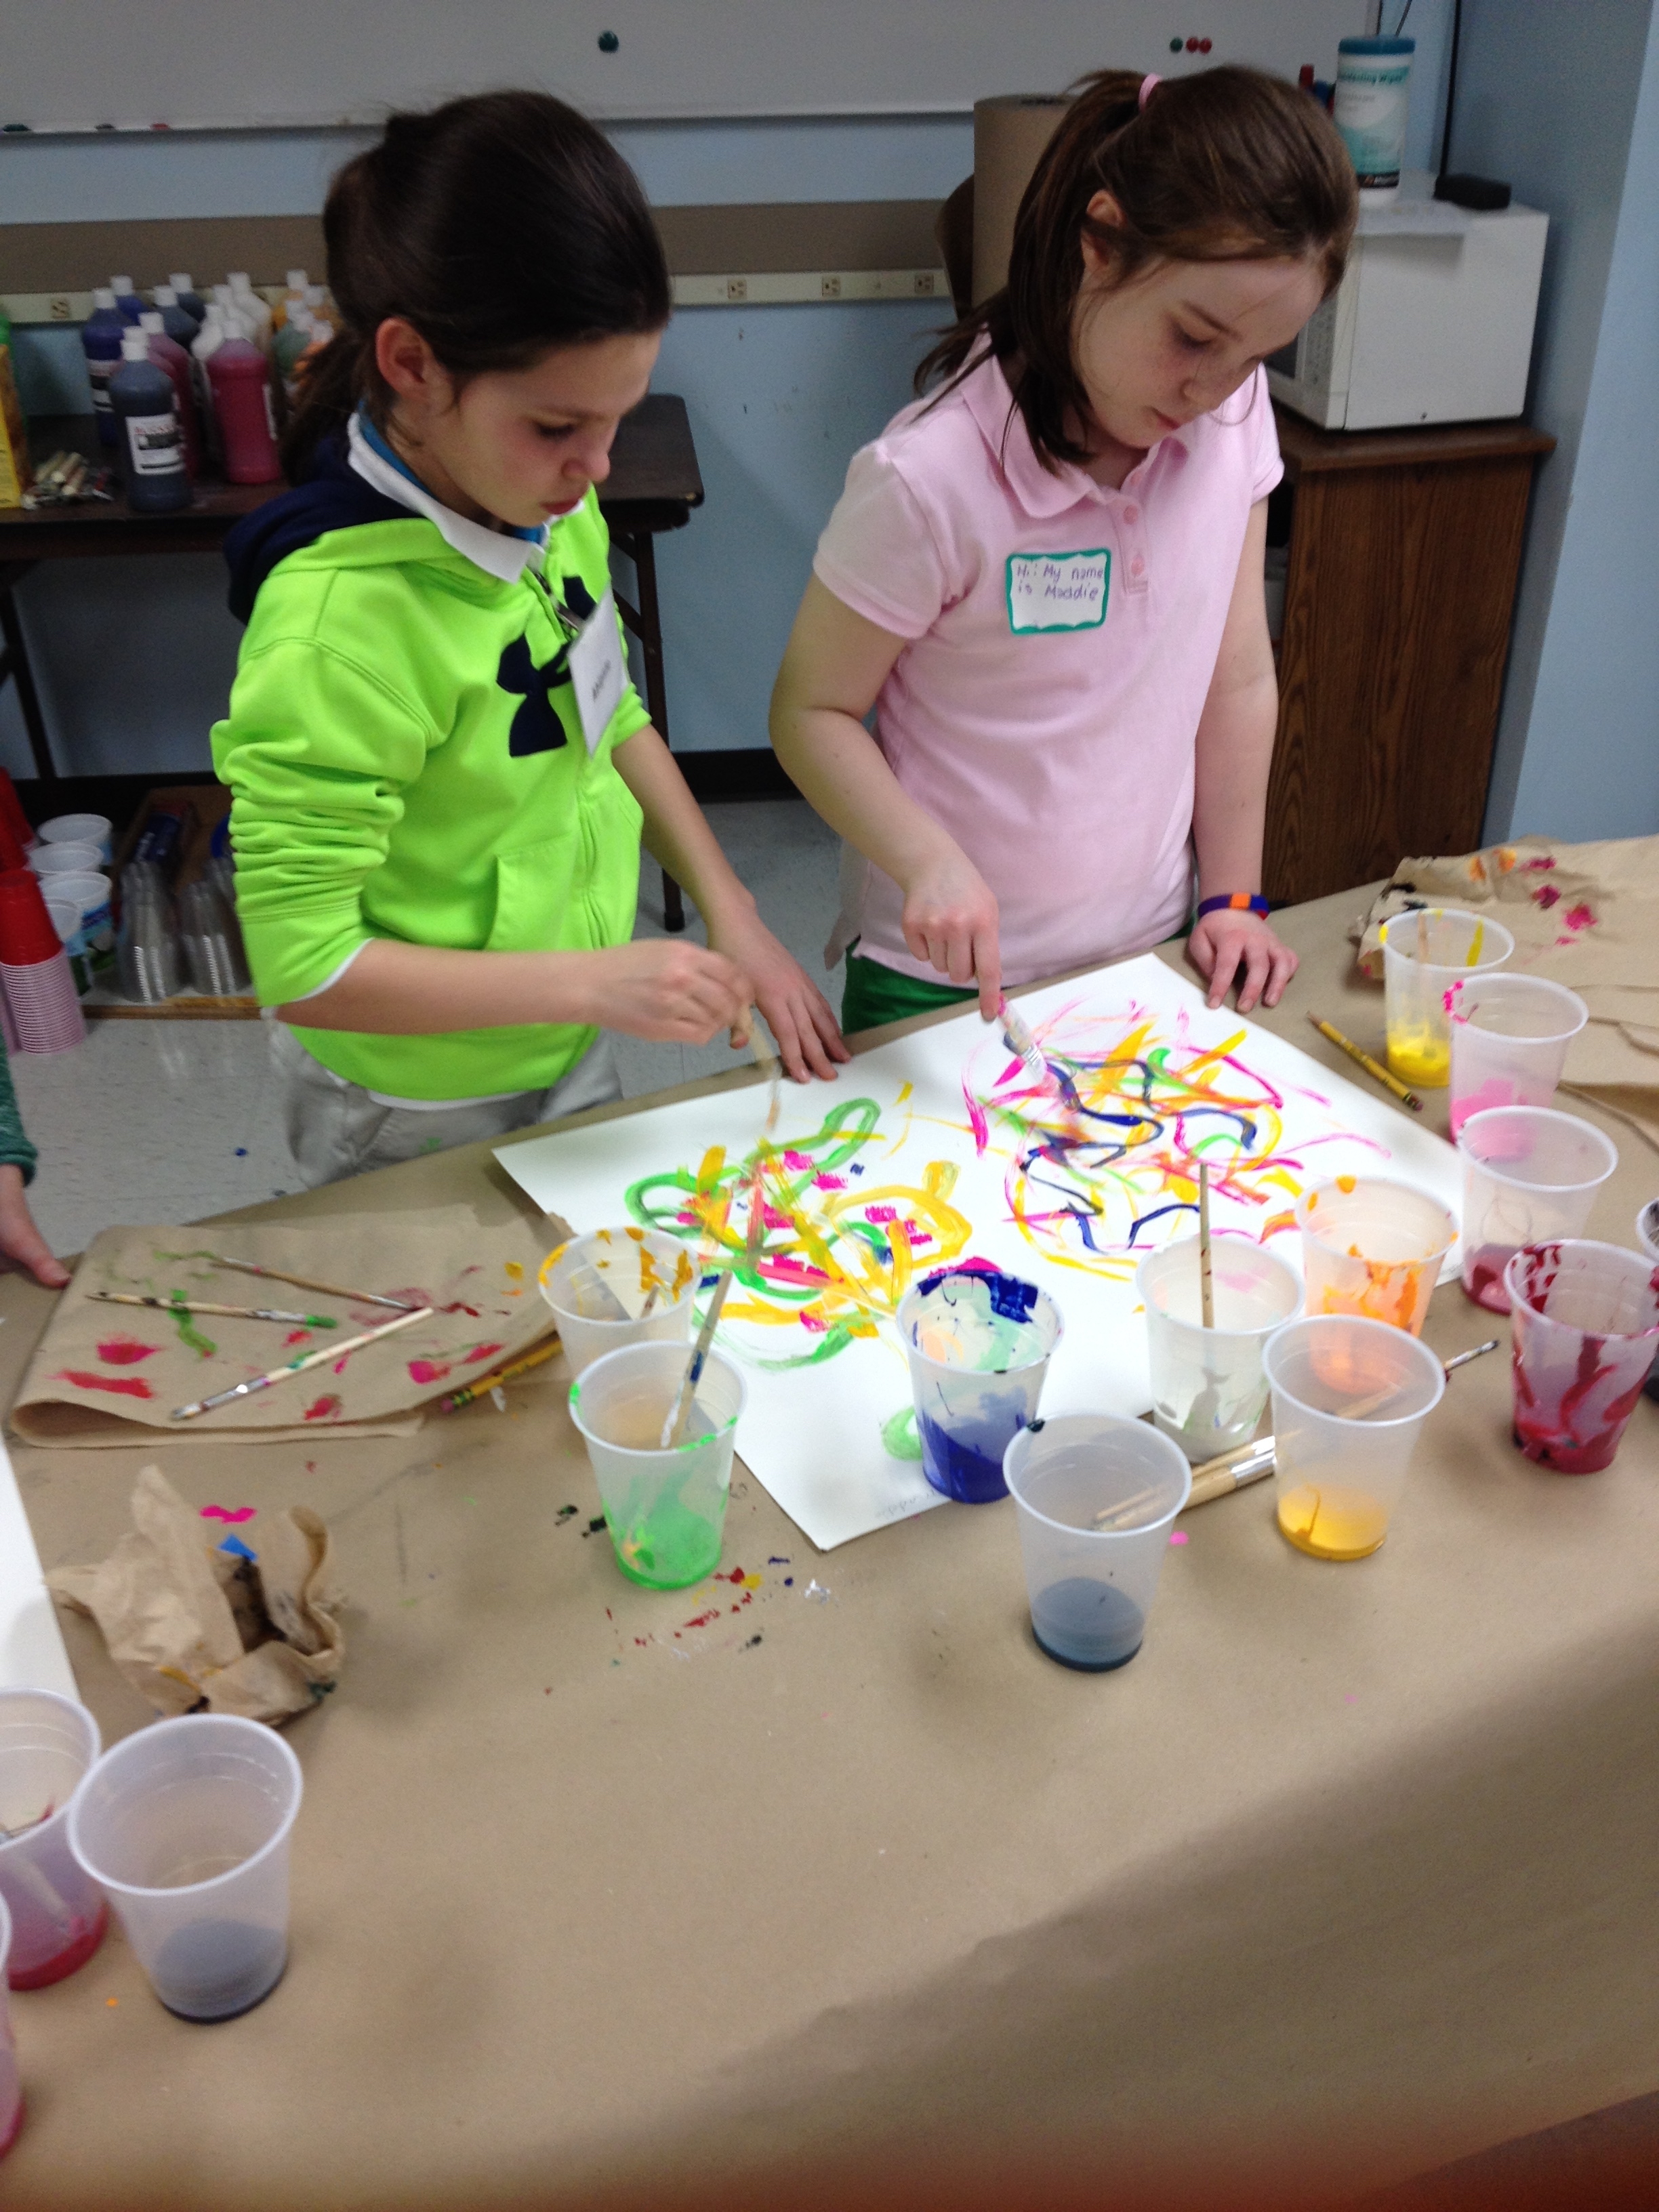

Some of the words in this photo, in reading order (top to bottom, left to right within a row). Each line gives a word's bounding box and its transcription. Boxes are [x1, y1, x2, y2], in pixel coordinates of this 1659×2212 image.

[1043, 562, 1061, 583] My
[1071, 568, 1103, 580] name
[1019, 579, 1033, 595] is
[1044, 582, 1099, 602] Maddie
